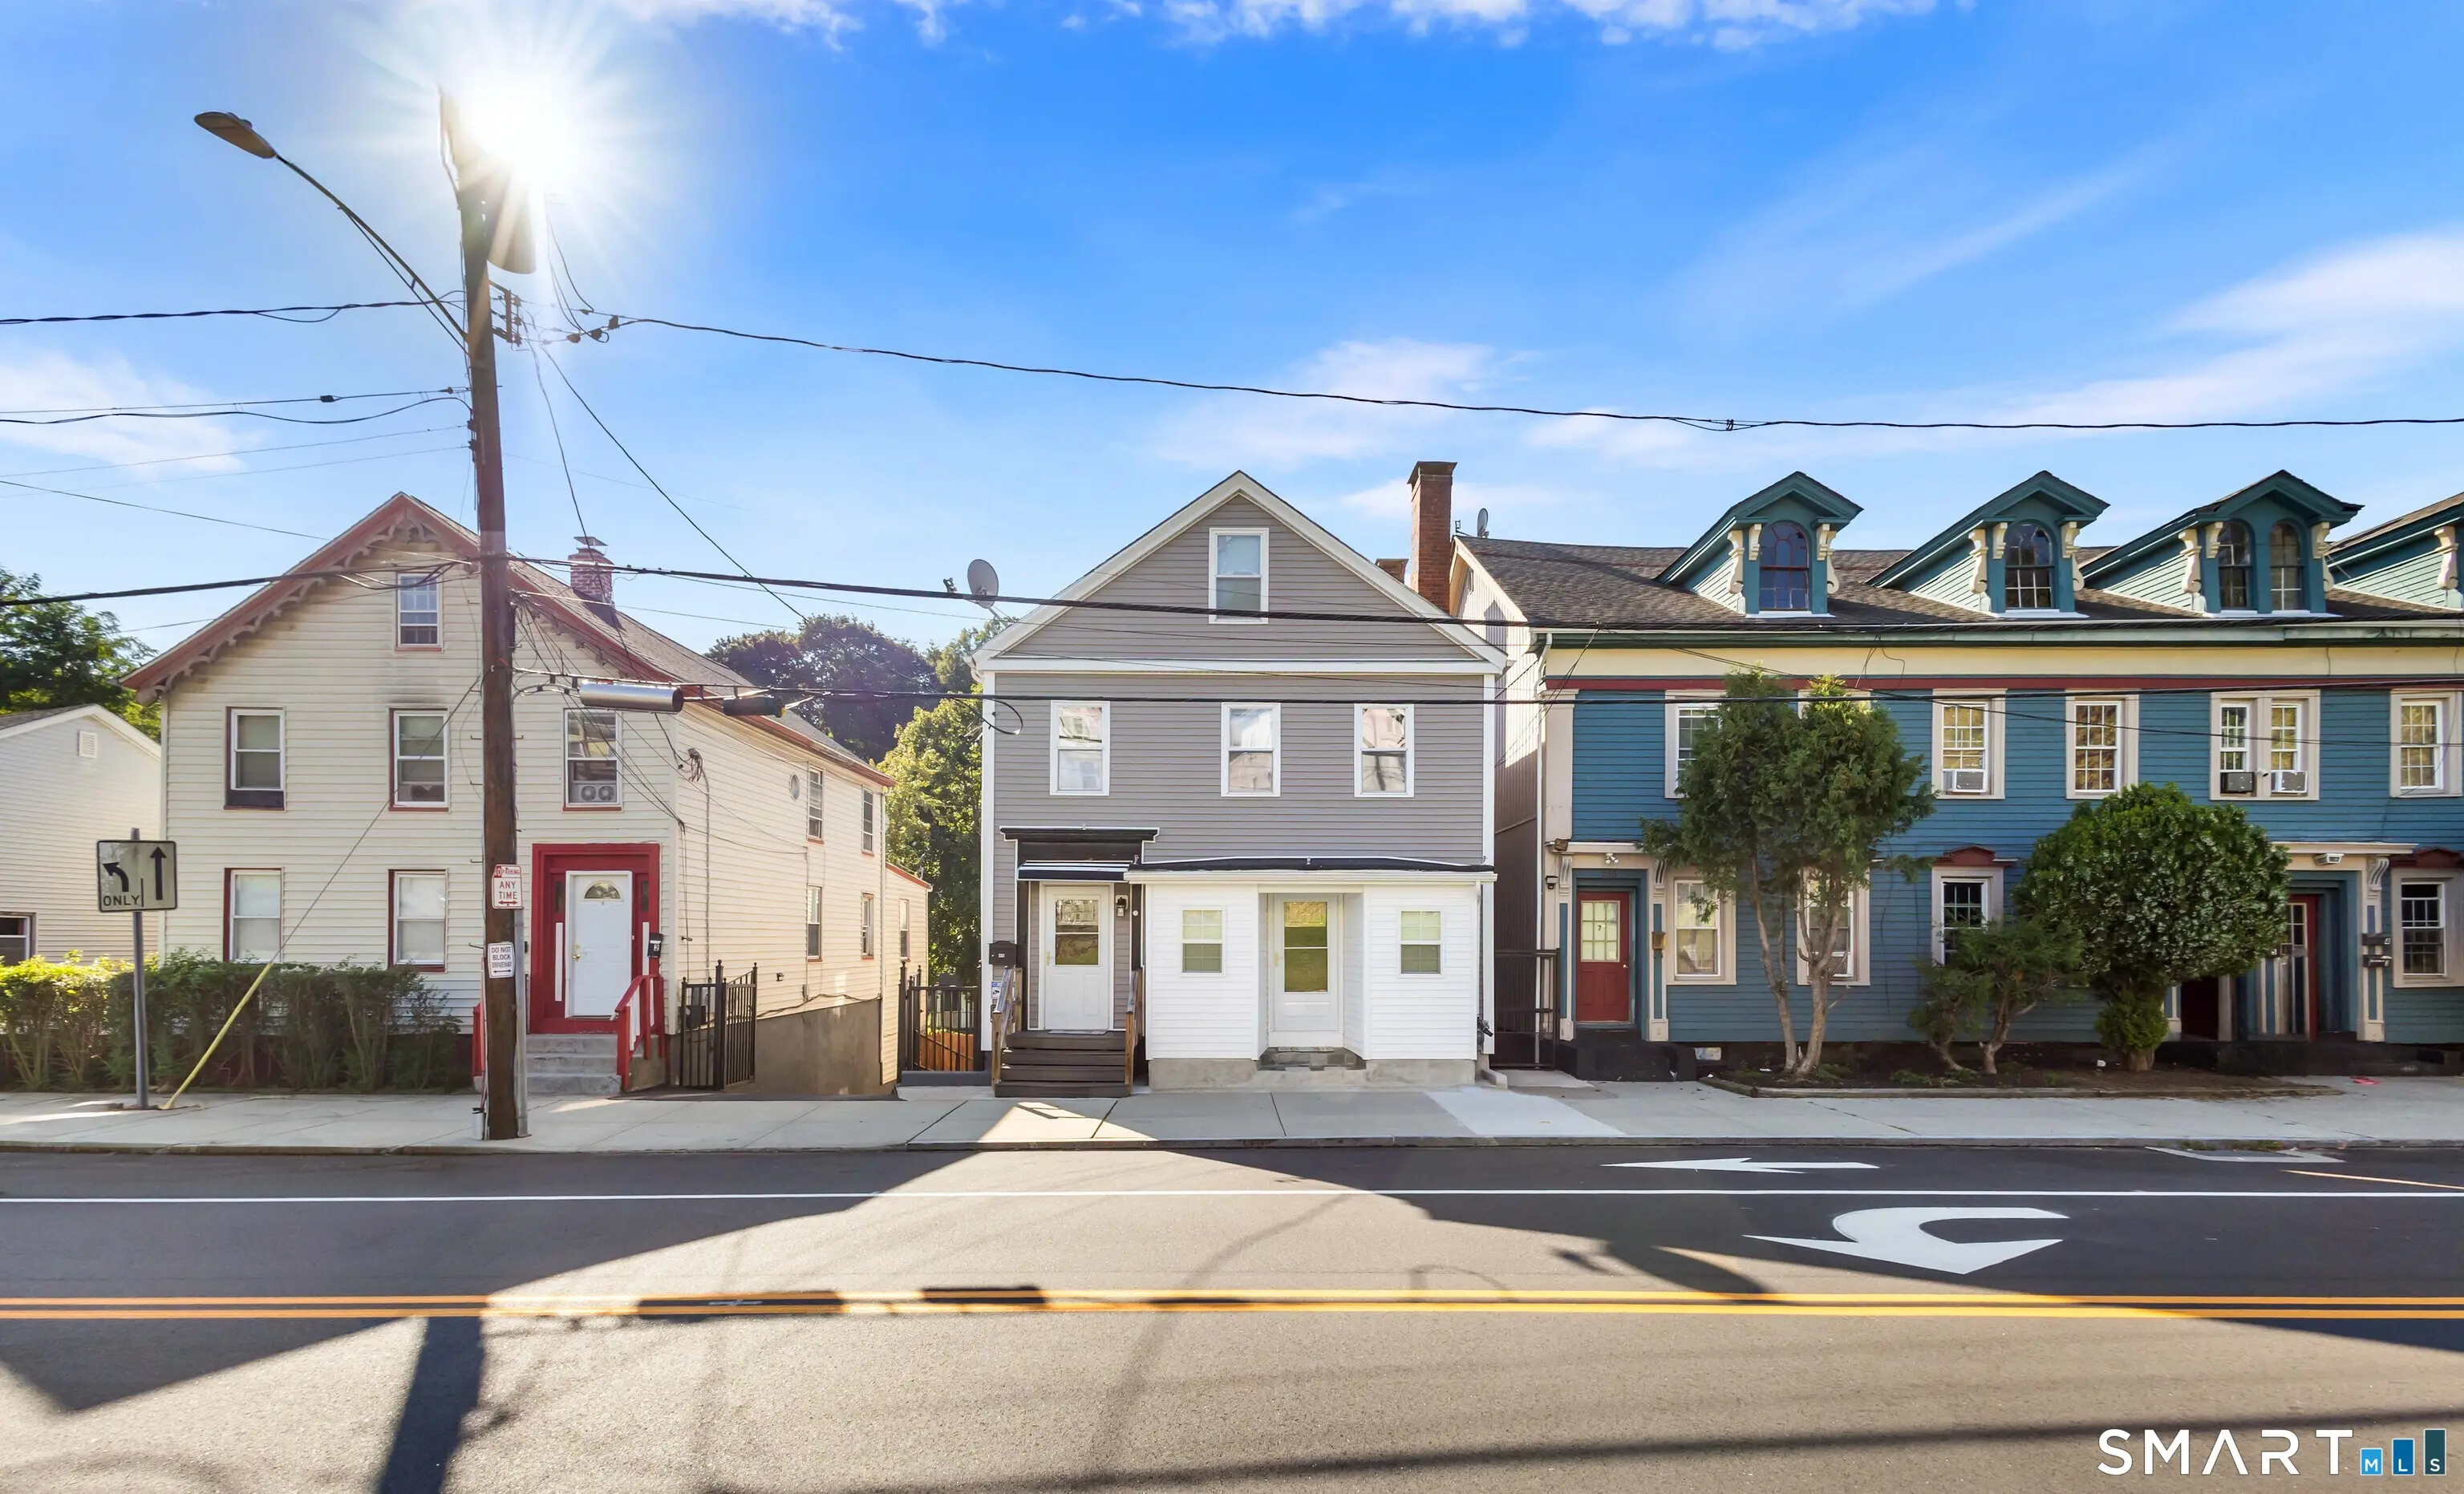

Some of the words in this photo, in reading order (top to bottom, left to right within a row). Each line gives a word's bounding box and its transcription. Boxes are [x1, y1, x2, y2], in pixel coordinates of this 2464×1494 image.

[499, 881, 517, 889] ANY
[498, 891, 517, 900] TIME
[103, 895, 140, 906] ONLY
